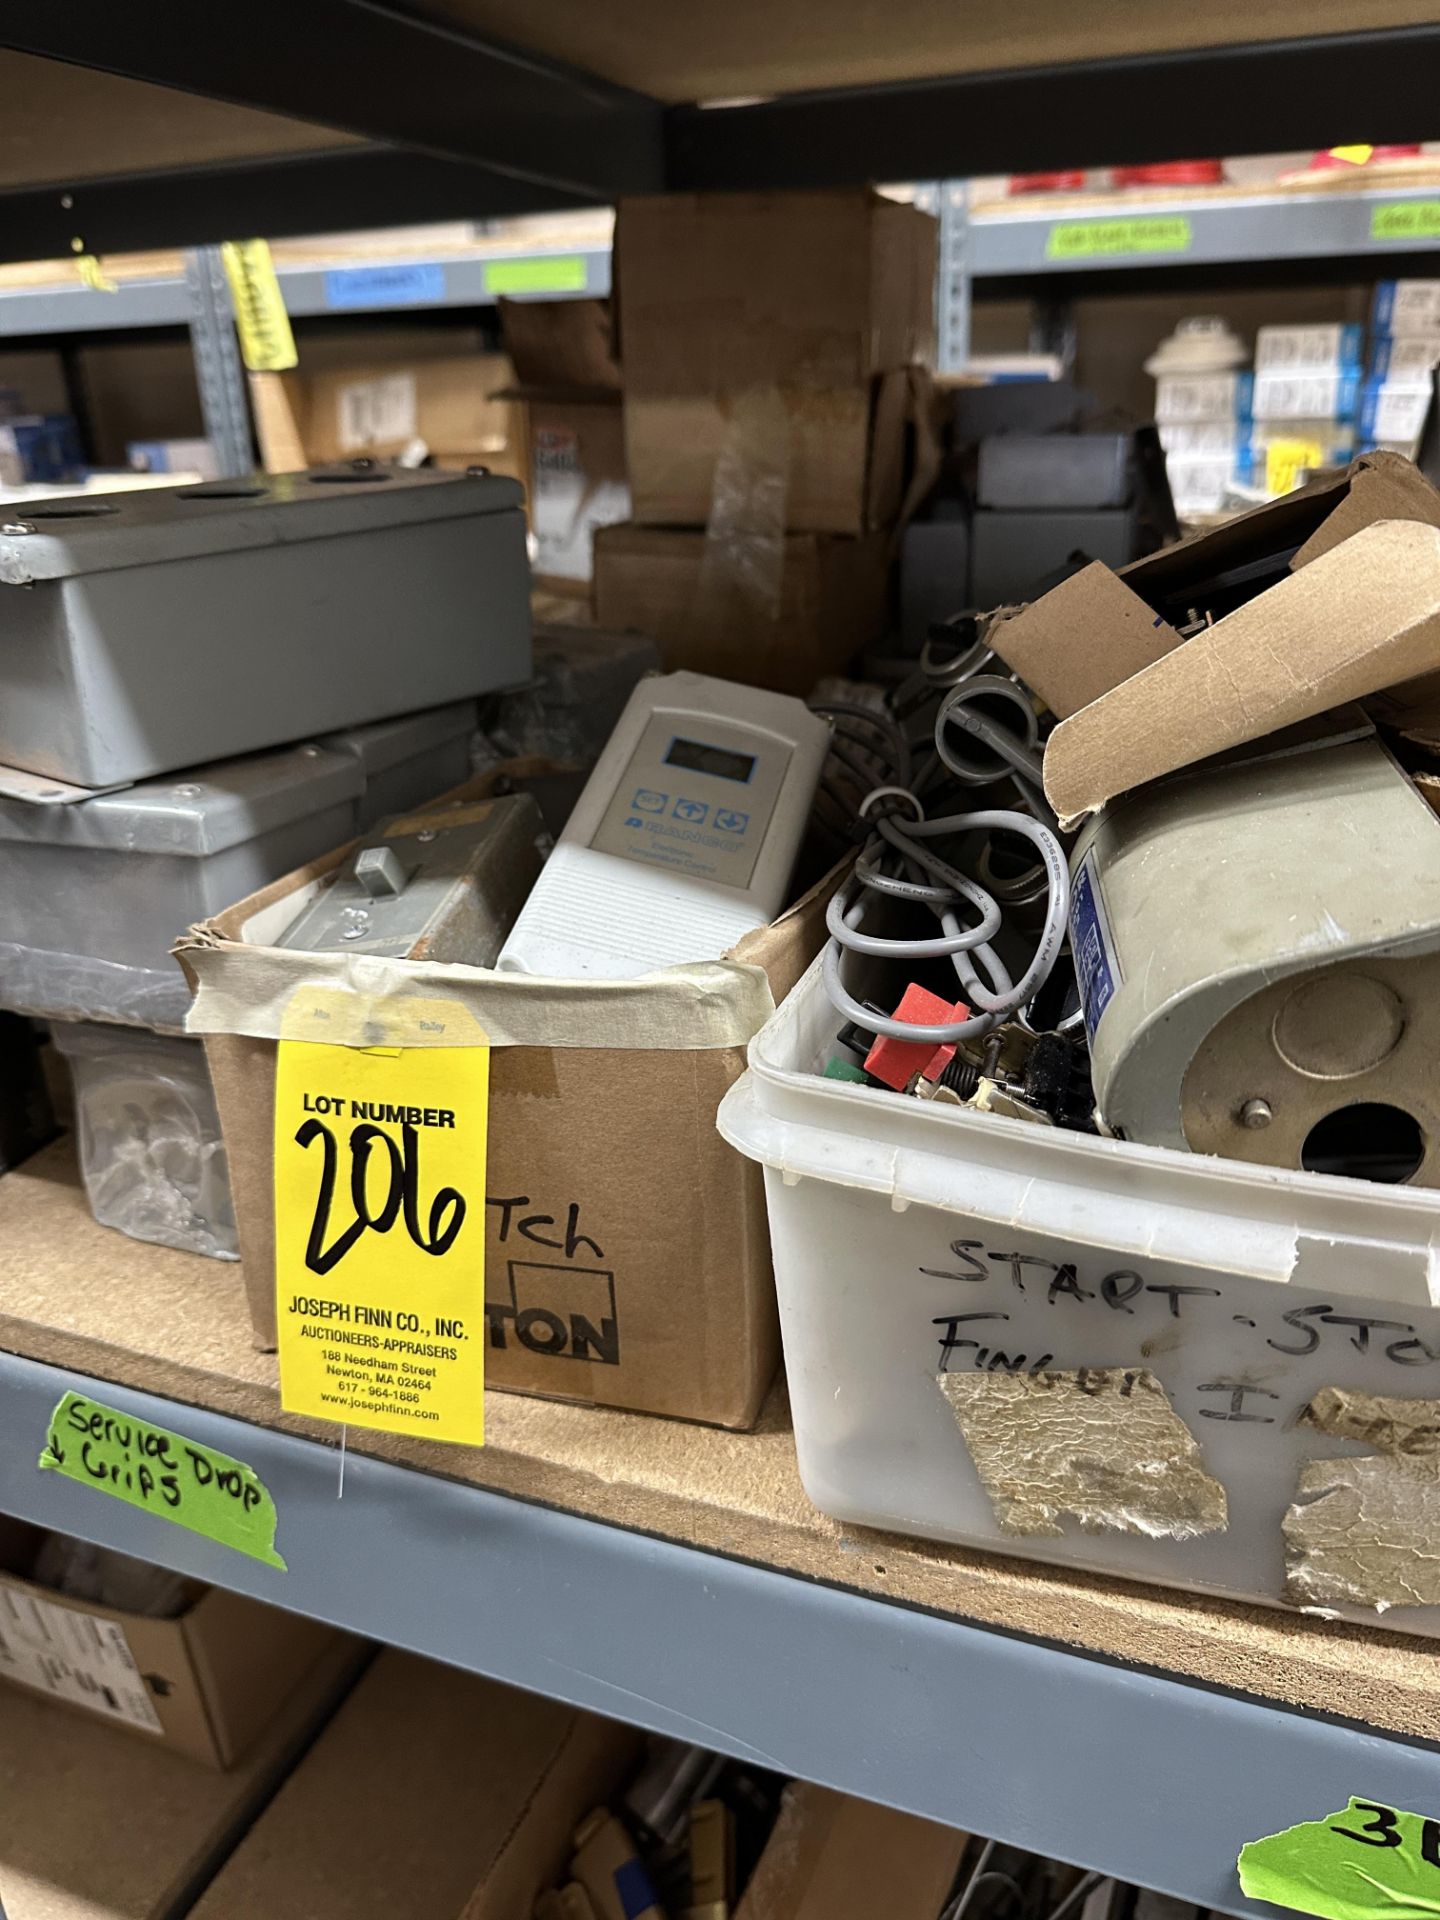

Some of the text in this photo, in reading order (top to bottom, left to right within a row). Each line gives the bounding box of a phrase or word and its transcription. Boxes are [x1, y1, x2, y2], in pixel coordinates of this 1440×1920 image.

[303, 1093, 456, 1129] LOT NUMBER
[294, 1118, 467, 1276] 206
[919, 1238, 1221, 1318] START
[289, 1296, 469, 1341] JOSEPH FINN CO., INC.
[301, 1324, 458, 1361] AUCTIONEERS-APPRAISERS
[321, 1349, 437, 1378] 188 Needham Street
[326, 1364, 432, 1392] Newton, MA 02464
[320, 1391, 440, 1422] www.josephfinn.com
[338, 1380, 358, 1393] 617
[368, 1384, 420, 1404] 964-1886
